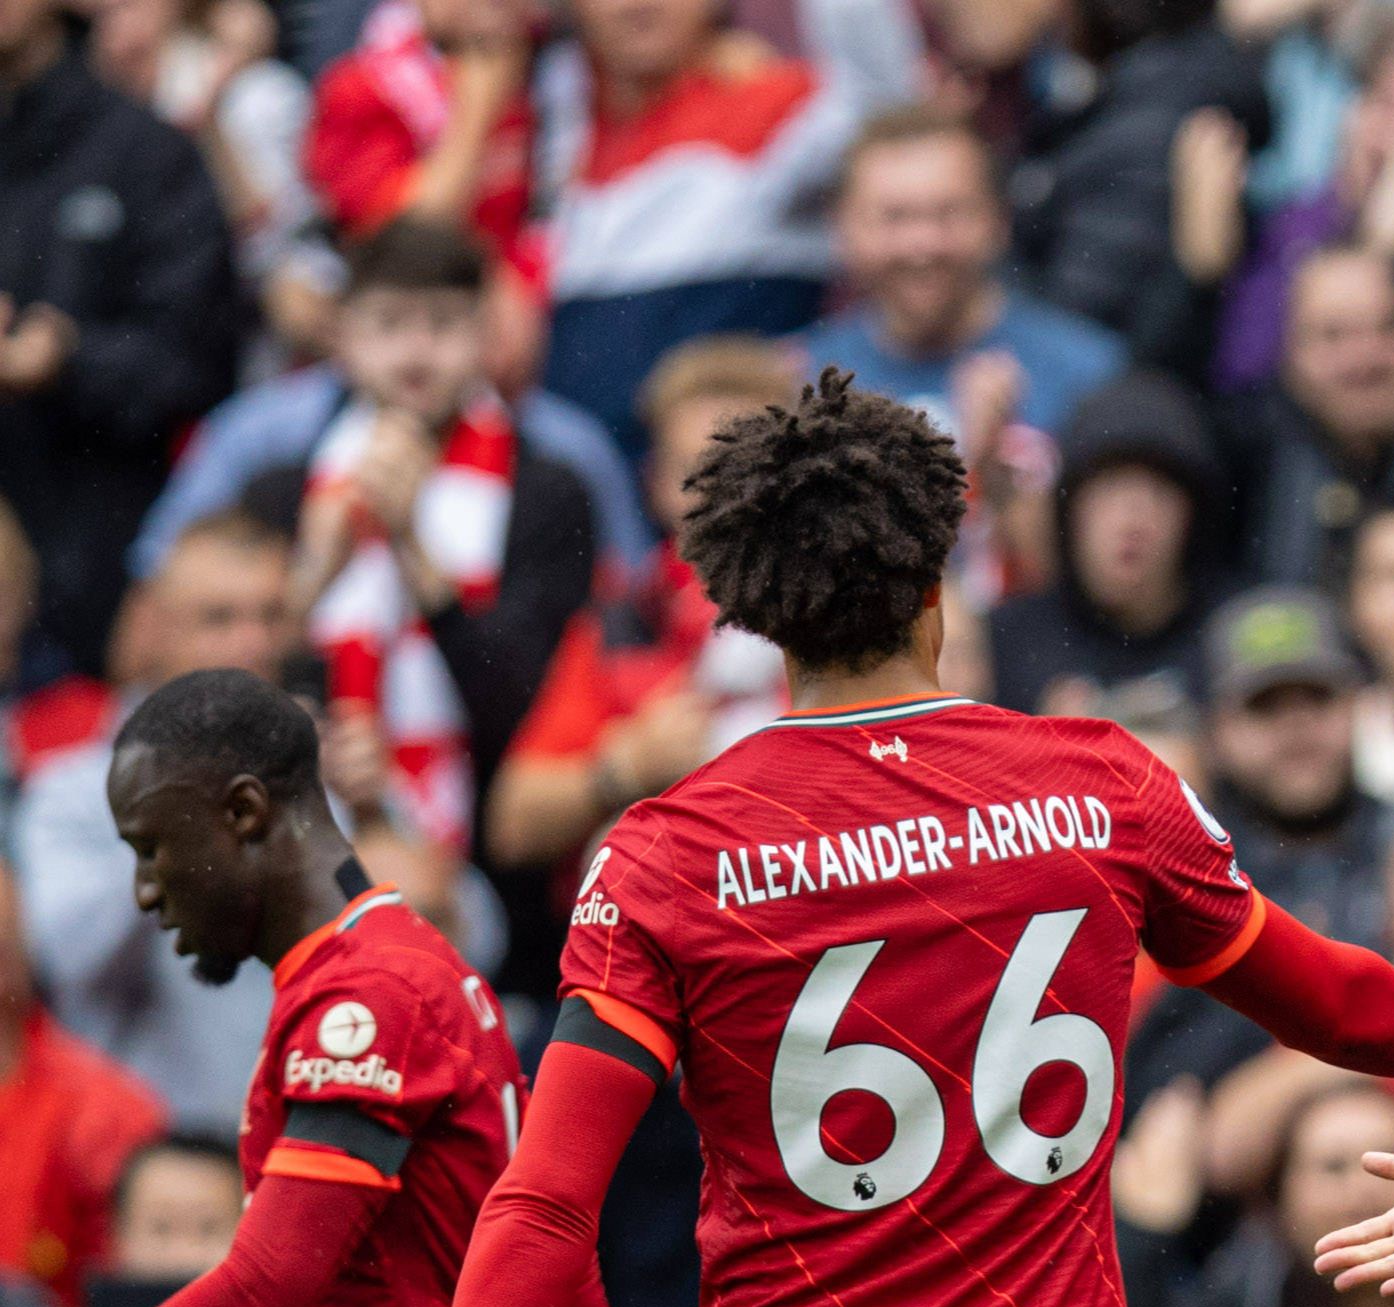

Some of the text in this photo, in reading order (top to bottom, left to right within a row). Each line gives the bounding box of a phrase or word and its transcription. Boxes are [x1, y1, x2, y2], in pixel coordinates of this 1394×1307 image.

[716, 795, 1112, 910] ALEXANDER-ARNOLD
[284, 1049, 404, 1094] Expedia
[769, 906, 1115, 1212] 66
